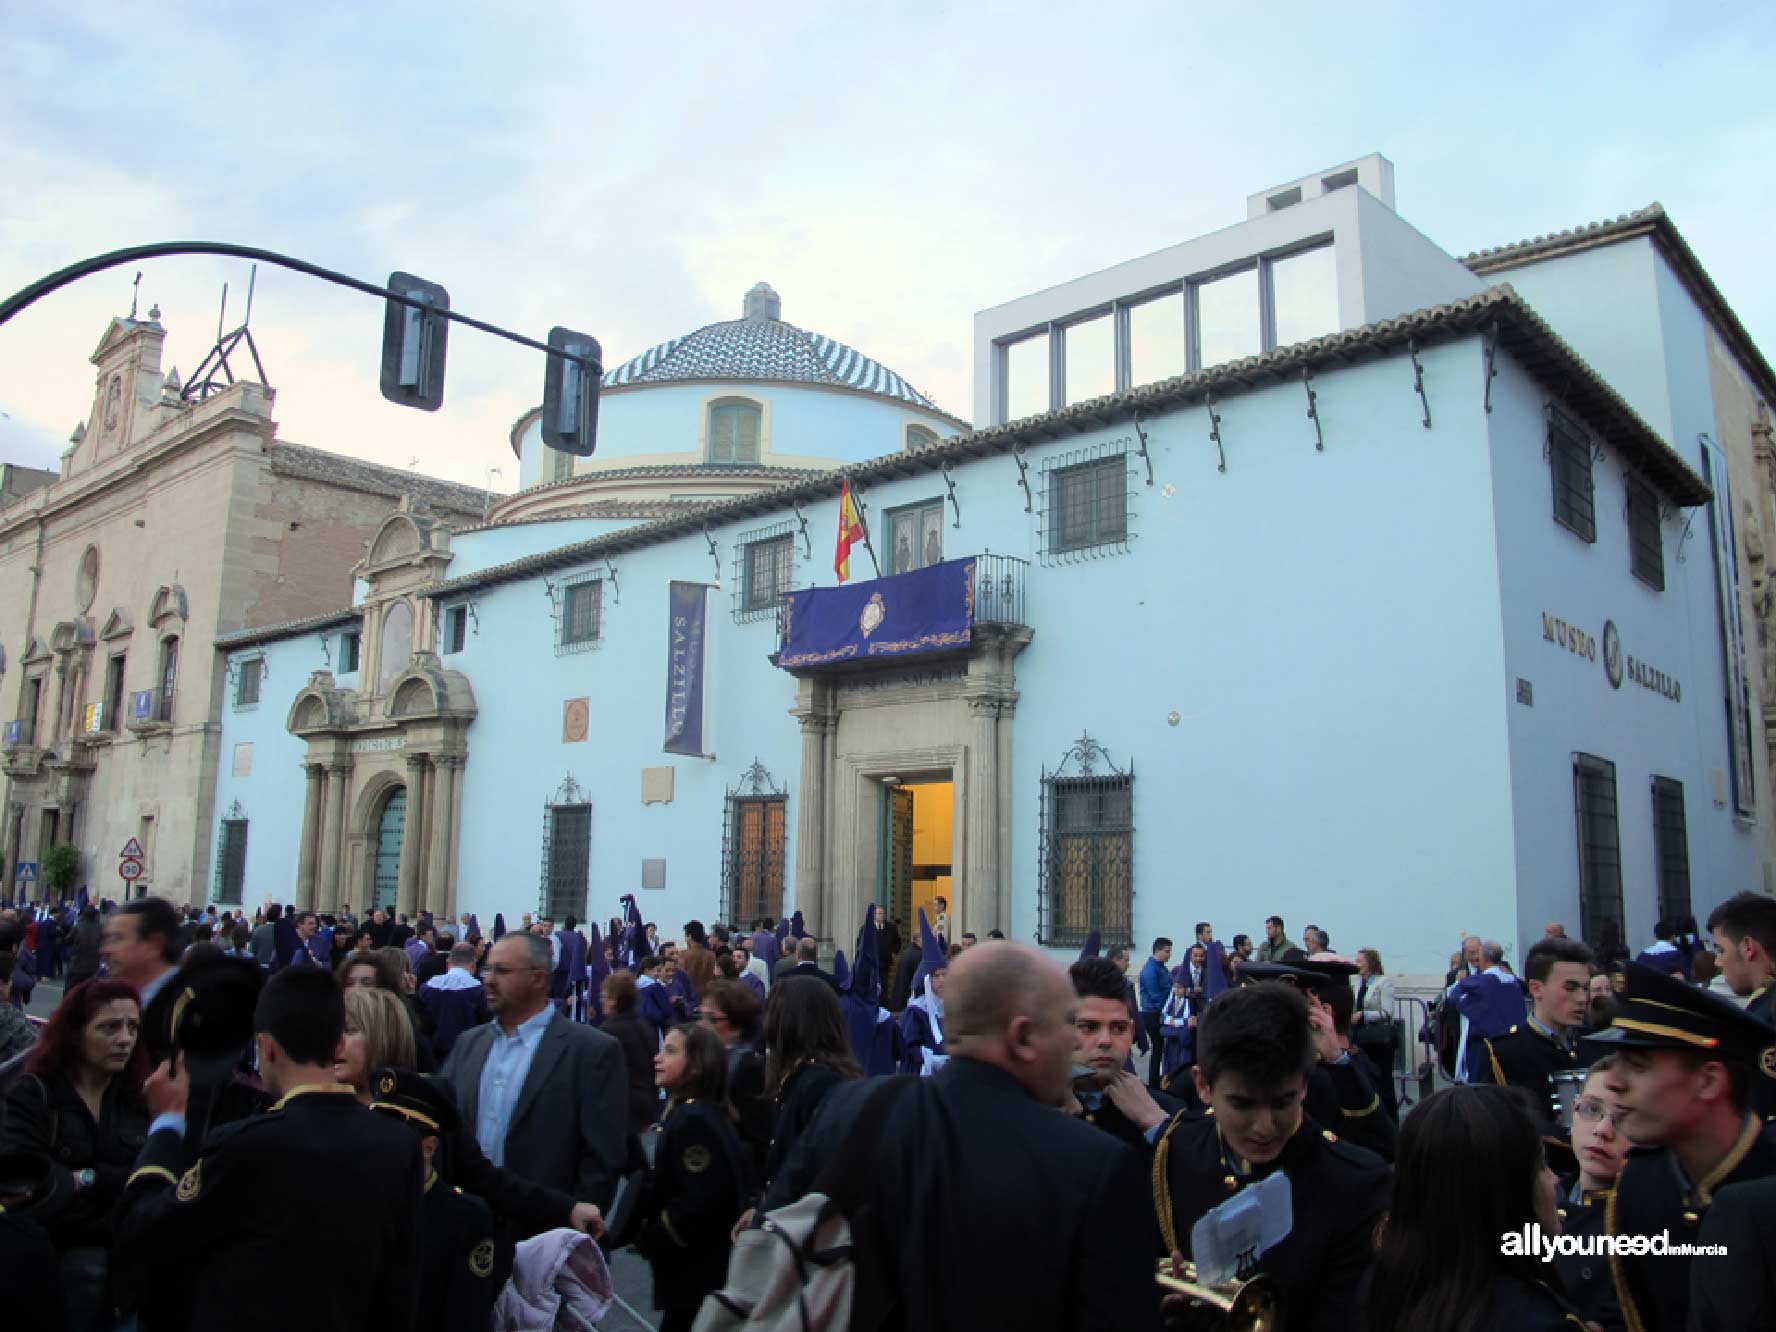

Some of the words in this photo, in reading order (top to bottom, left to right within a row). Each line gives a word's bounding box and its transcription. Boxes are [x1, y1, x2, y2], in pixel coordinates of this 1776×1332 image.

[671, 616, 687, 736] SALZILLO
[1542, 611, 1596, 663] MUSEO
[1627, 654, 1681, 703] SALZILLO
